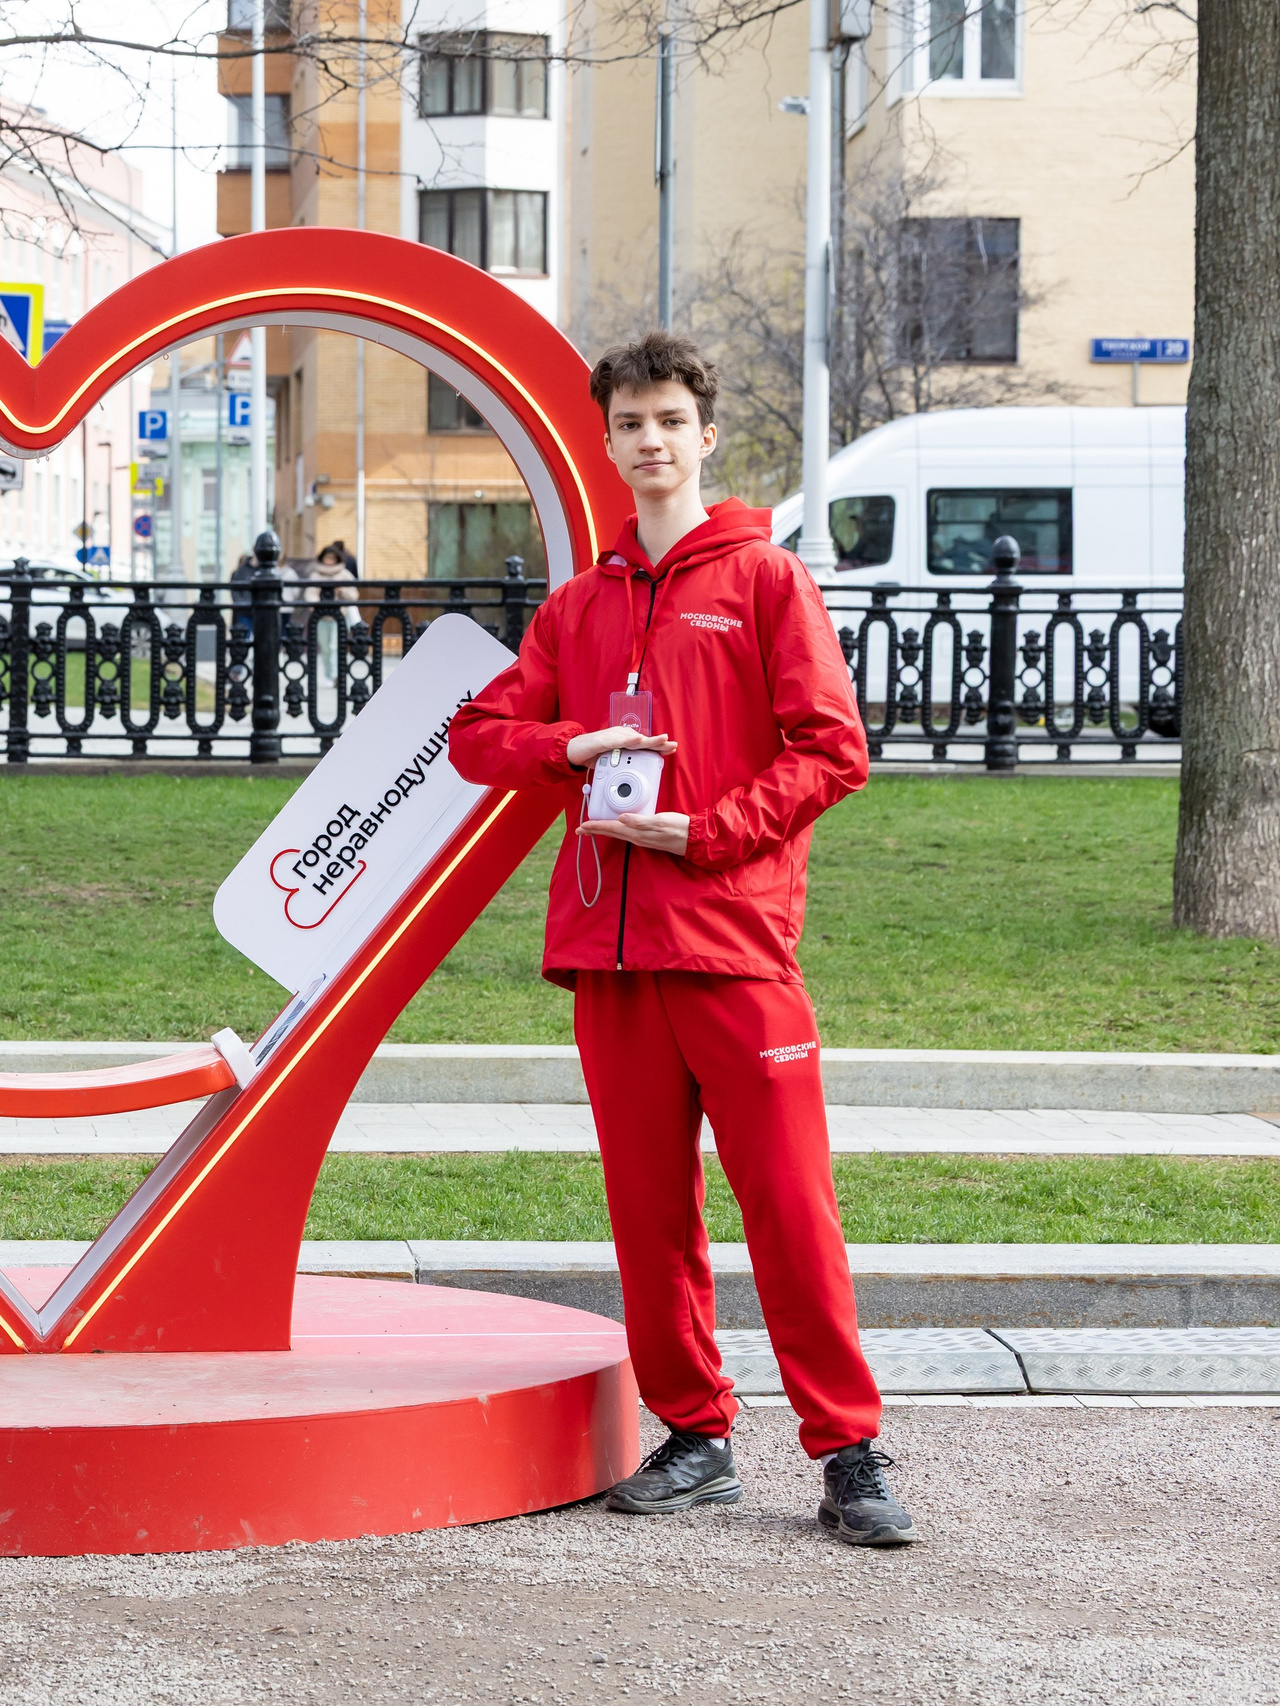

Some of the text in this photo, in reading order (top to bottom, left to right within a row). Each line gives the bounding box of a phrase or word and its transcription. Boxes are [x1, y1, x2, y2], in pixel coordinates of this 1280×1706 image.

[680, 612, 743, 628] МОСКОВСКИЕ
[690, 620, 730, 632] СЕЗОНЫ
[312, 690, 475, 895] неравнодушнх
[292, 803, 361, 879] город
[759, 1040, 817, 1059] МОСКОВСКИЕ
[773, 1051, 808, 1063] СЕЗОНЫ
